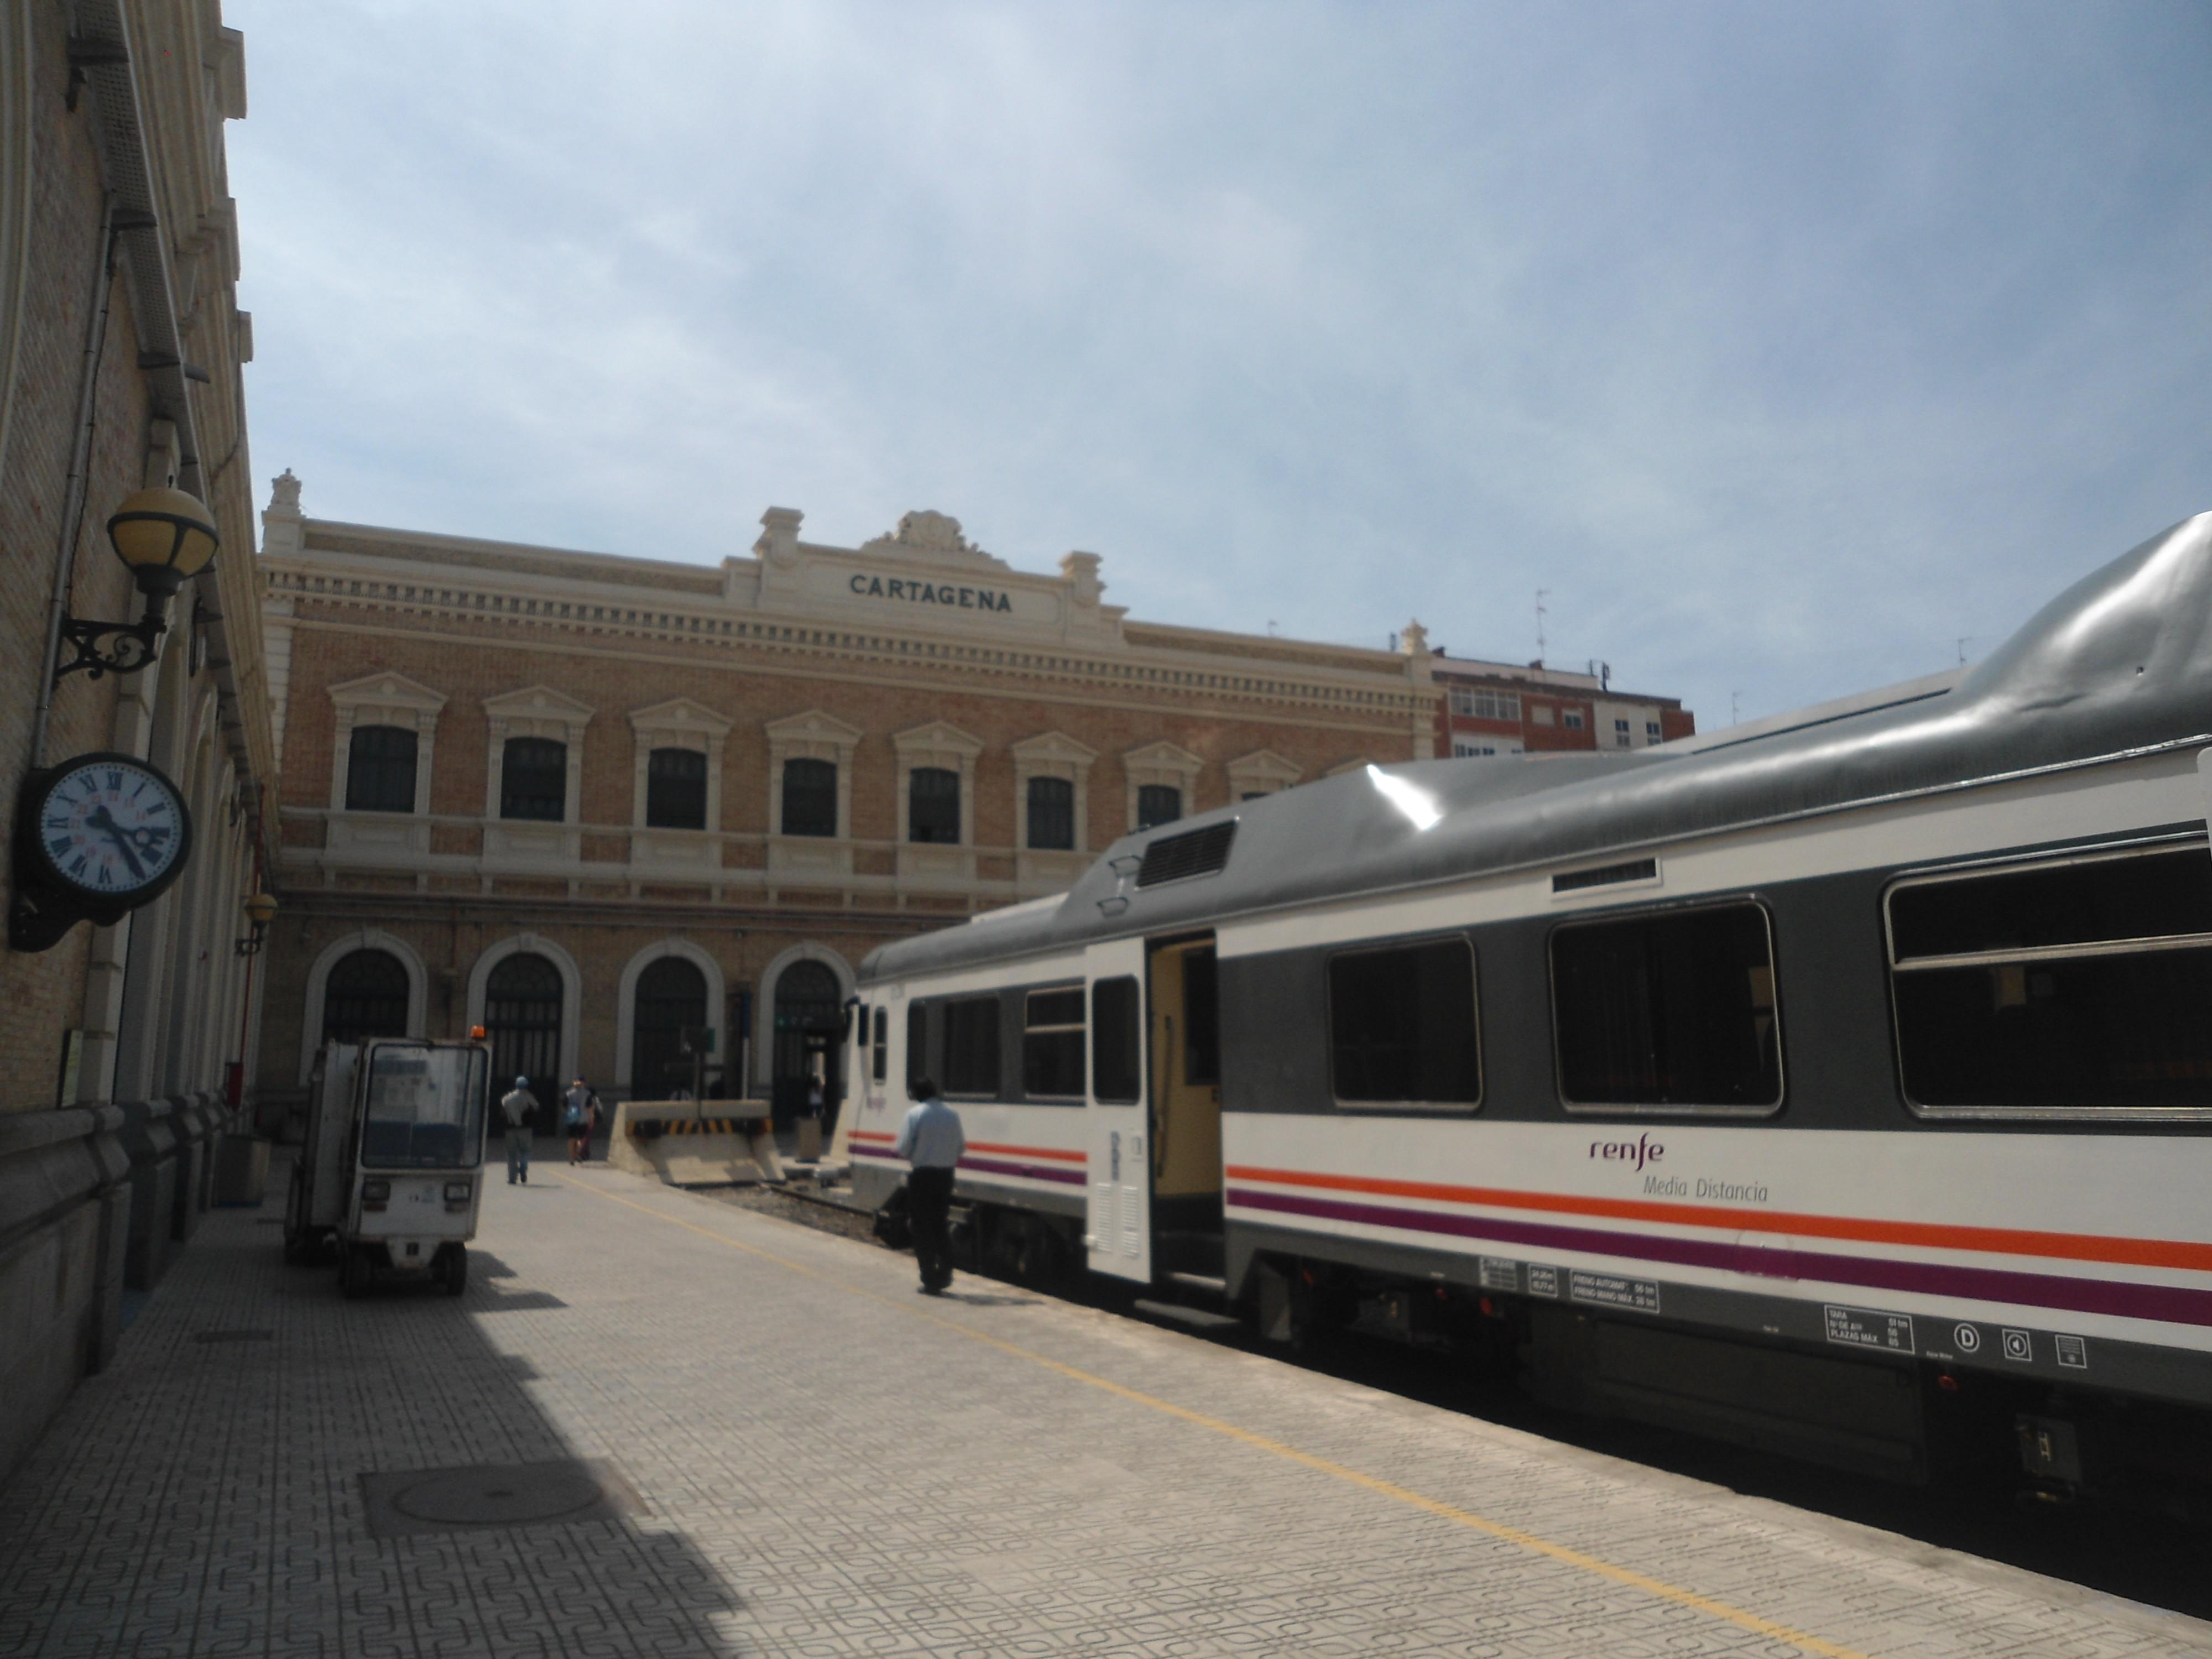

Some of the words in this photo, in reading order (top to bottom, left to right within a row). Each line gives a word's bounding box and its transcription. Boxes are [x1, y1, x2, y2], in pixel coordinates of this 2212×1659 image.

[850, 575, 1013, 613] CARTAGENA
[1589, 1132, 1665, 1171] renfe
[1644, 1176, 1687, 1196] Media
[1696, 1178, 1768, 1202] Distancia
[1831, 1329, 1859, 1341] PLAZAS
[1960, 1329, 1974, 1347] D
